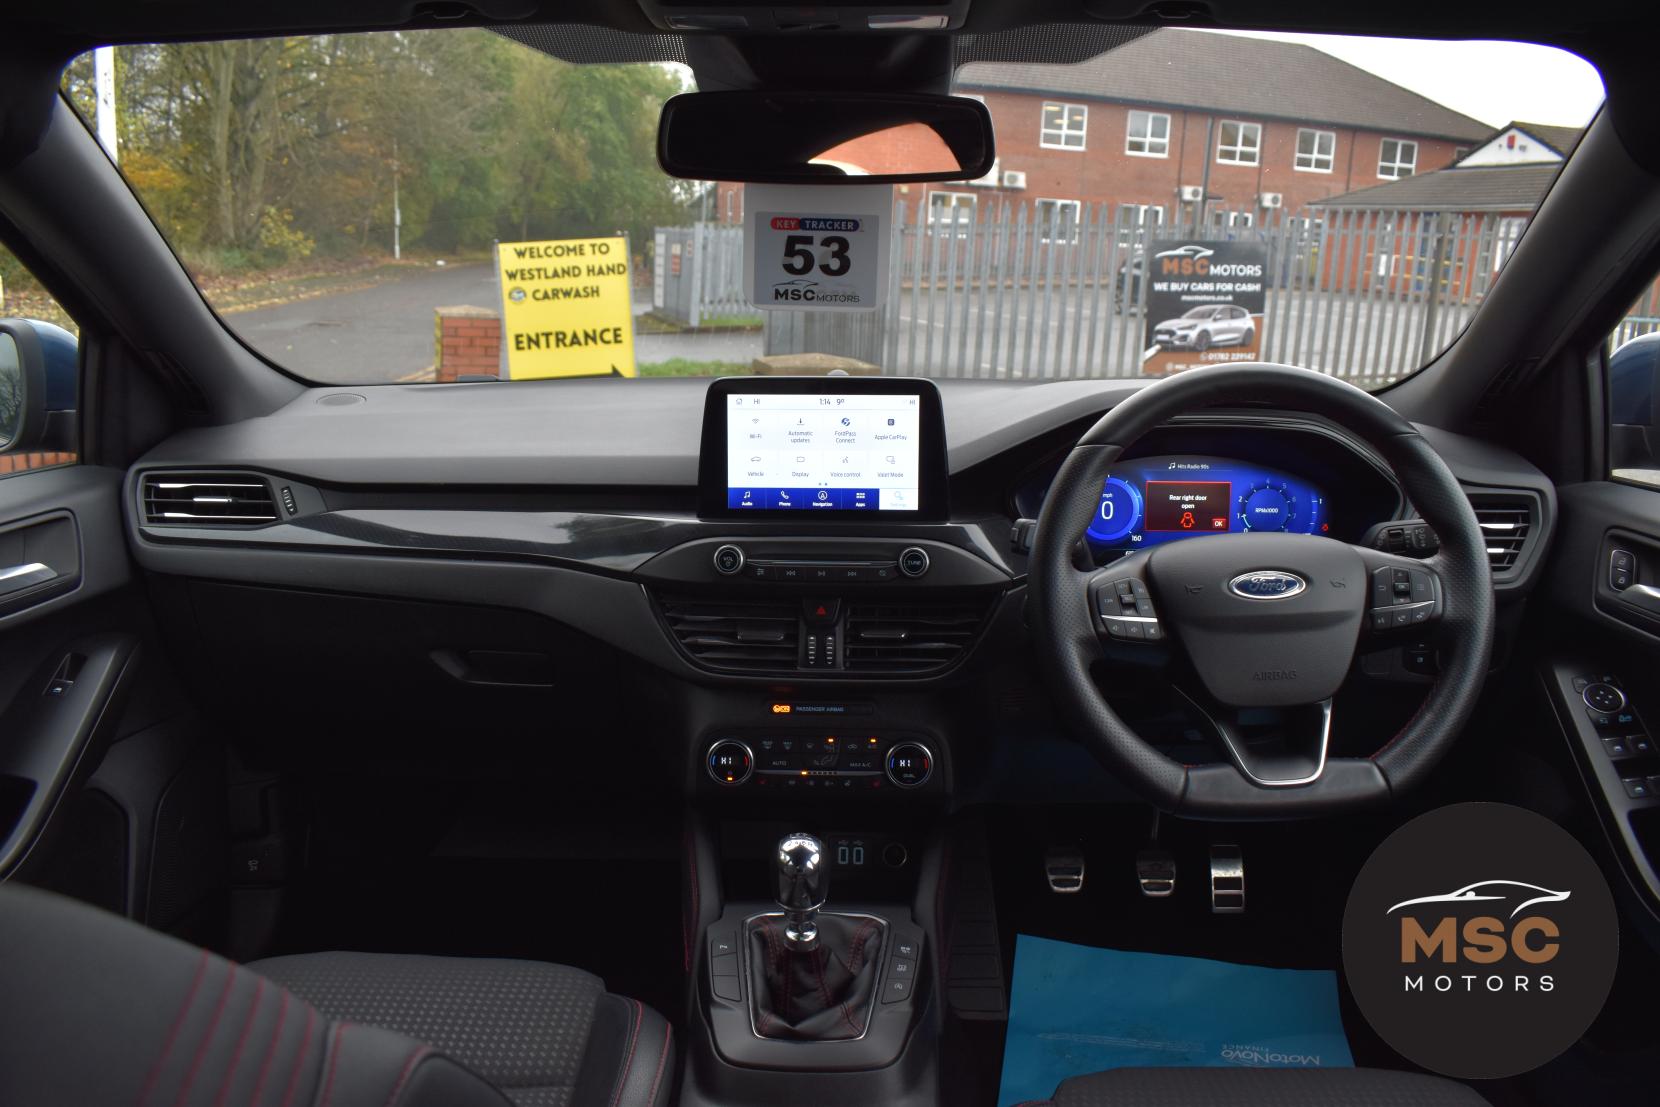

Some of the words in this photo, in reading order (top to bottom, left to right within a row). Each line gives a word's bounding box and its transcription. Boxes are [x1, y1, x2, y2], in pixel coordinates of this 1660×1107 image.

[776, 219, 796, 229] KEY
[805, 220, 854, 230] TRACKER
[514, 244, 585, 259] WELCOME
[590, 242, 610, 255] TO
[782, 235, 851, 277] 53
[505, 266, 582, 281] WESTLAND
[586, 263, 626, 277] HAND
[1161, 257, 1209, 276] MSC
[1210, 264, 1262, 277] MOTORS
[532, 286, 600, 301] CARWASH
[1153, 282, 1169, 292] WE
[1170, 282, 1189, 292] BUY
[1190, 282, 1215, 292] CARS
[1216, 282, 1234, 292] FOR
[774, 288, 816, 302] MSC
[816, 294, 860, 303] MOTORS
[514, 327, 623, 351] ENTRANCE
[819, 398, 831, 406] 1:14
[1182, 494, 1194, 502] right
[1101, 500, 1114, 520] 0
[1254, 670, 1297, 681] AIRBAG
[1220, 1050, 1320, 1066] MotoNovo
